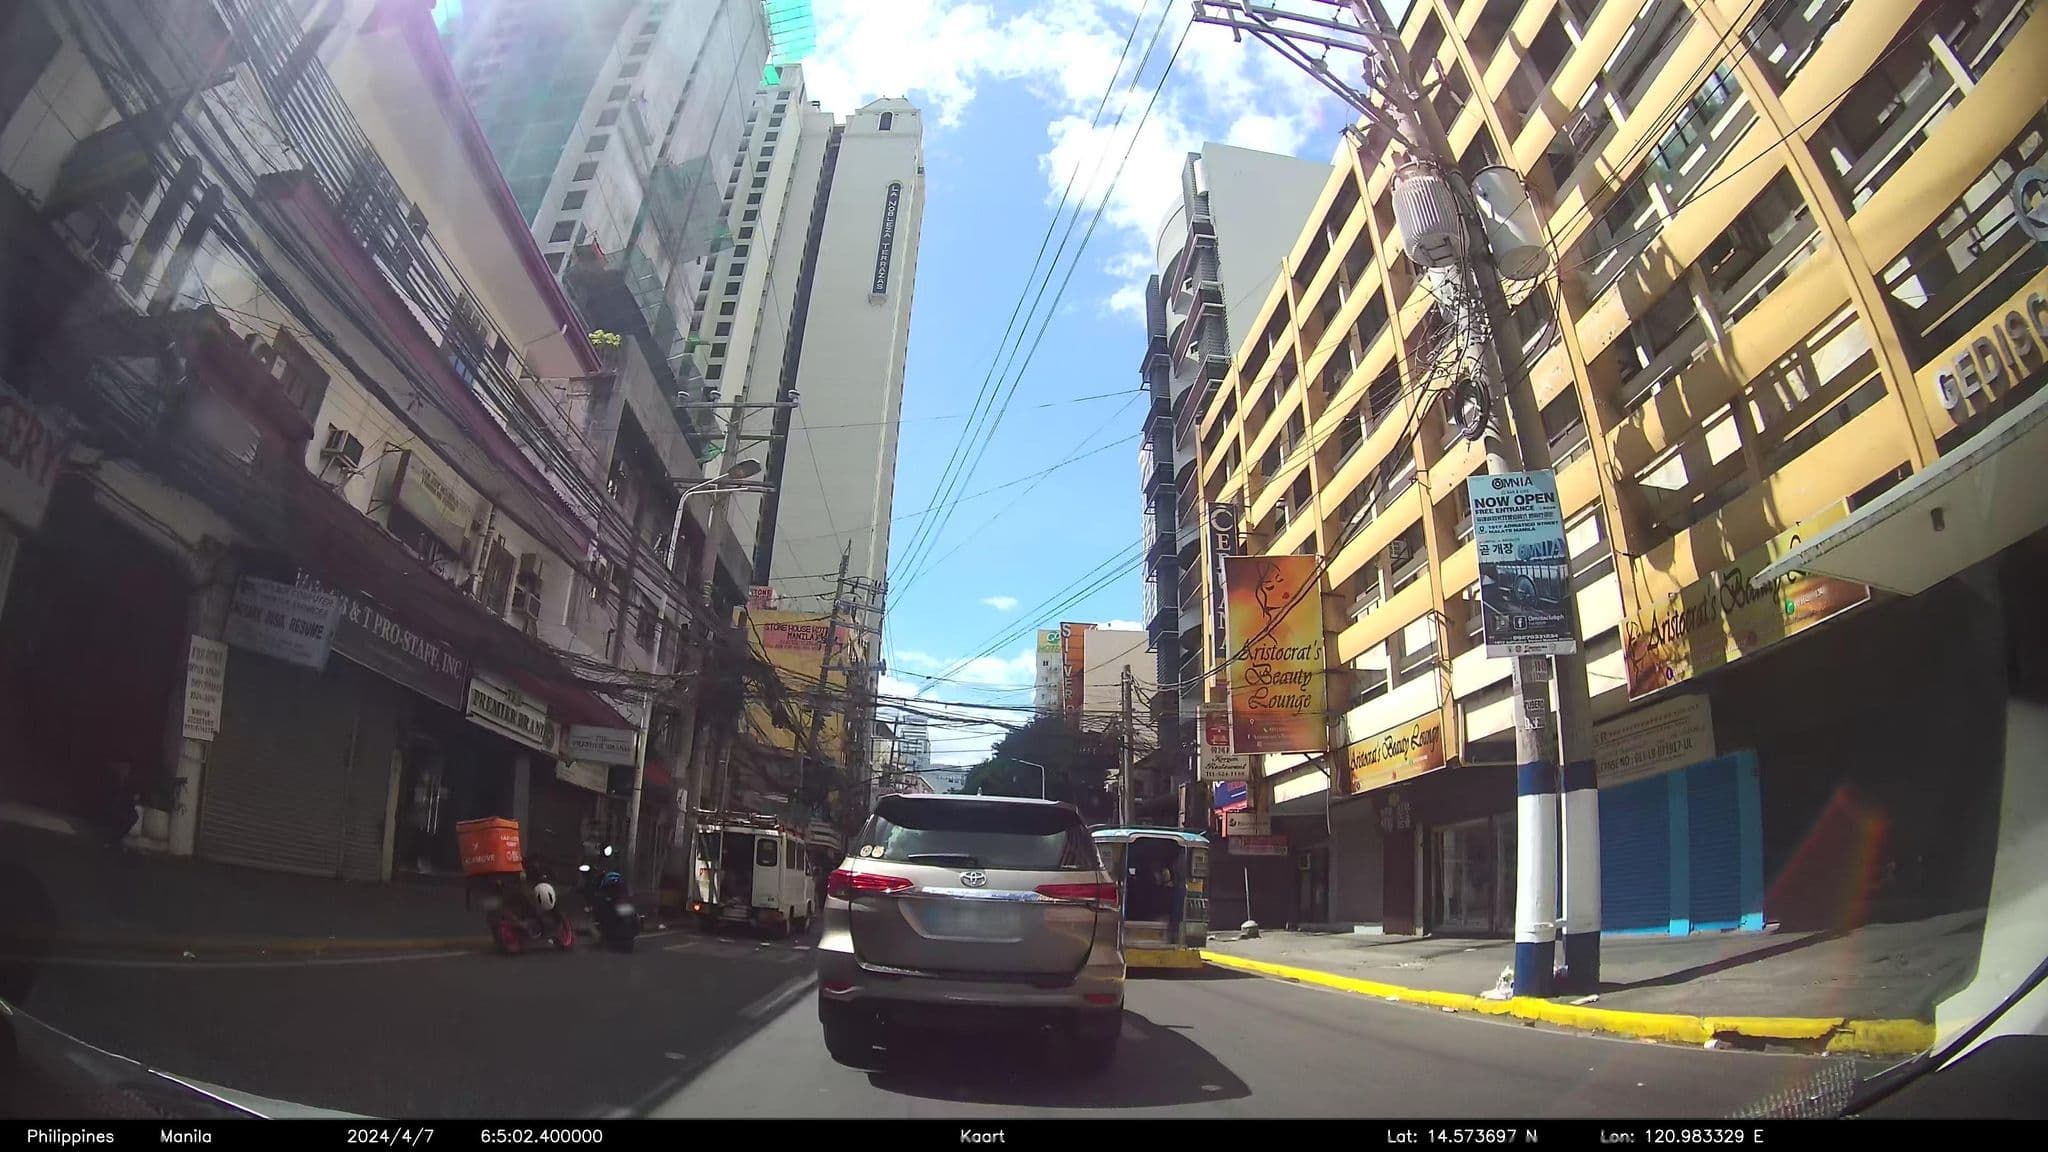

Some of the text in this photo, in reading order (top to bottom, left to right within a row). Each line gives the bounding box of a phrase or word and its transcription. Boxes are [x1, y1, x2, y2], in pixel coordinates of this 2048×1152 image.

[1491, 476, 1534, 490] OMNIA
[1474, 492, 1555, 509] NOW OPEN
[1495, 505, 1535, 513] ENTRANCE
[349, 599, 361, 624] &
[361, 606, 372, 629] T
[1647, 591, 1717, 651] Aristocrat's
[288, 617, 325, 640] RESUME
[787, 632, 818, 641] MANILA
[788, 624, 812, 634] HOUSE
[1237, 639, 1322, 663] Aristocrat's
[1245, 662, 1313, 692] Beauty
[472, 688, 517, 723] PREMIER
[1248, 686, 1312, 717] Lounge
[1381, 735, 1410, 761] Beauty
[1410, 723, 1441, 753] Lounge
